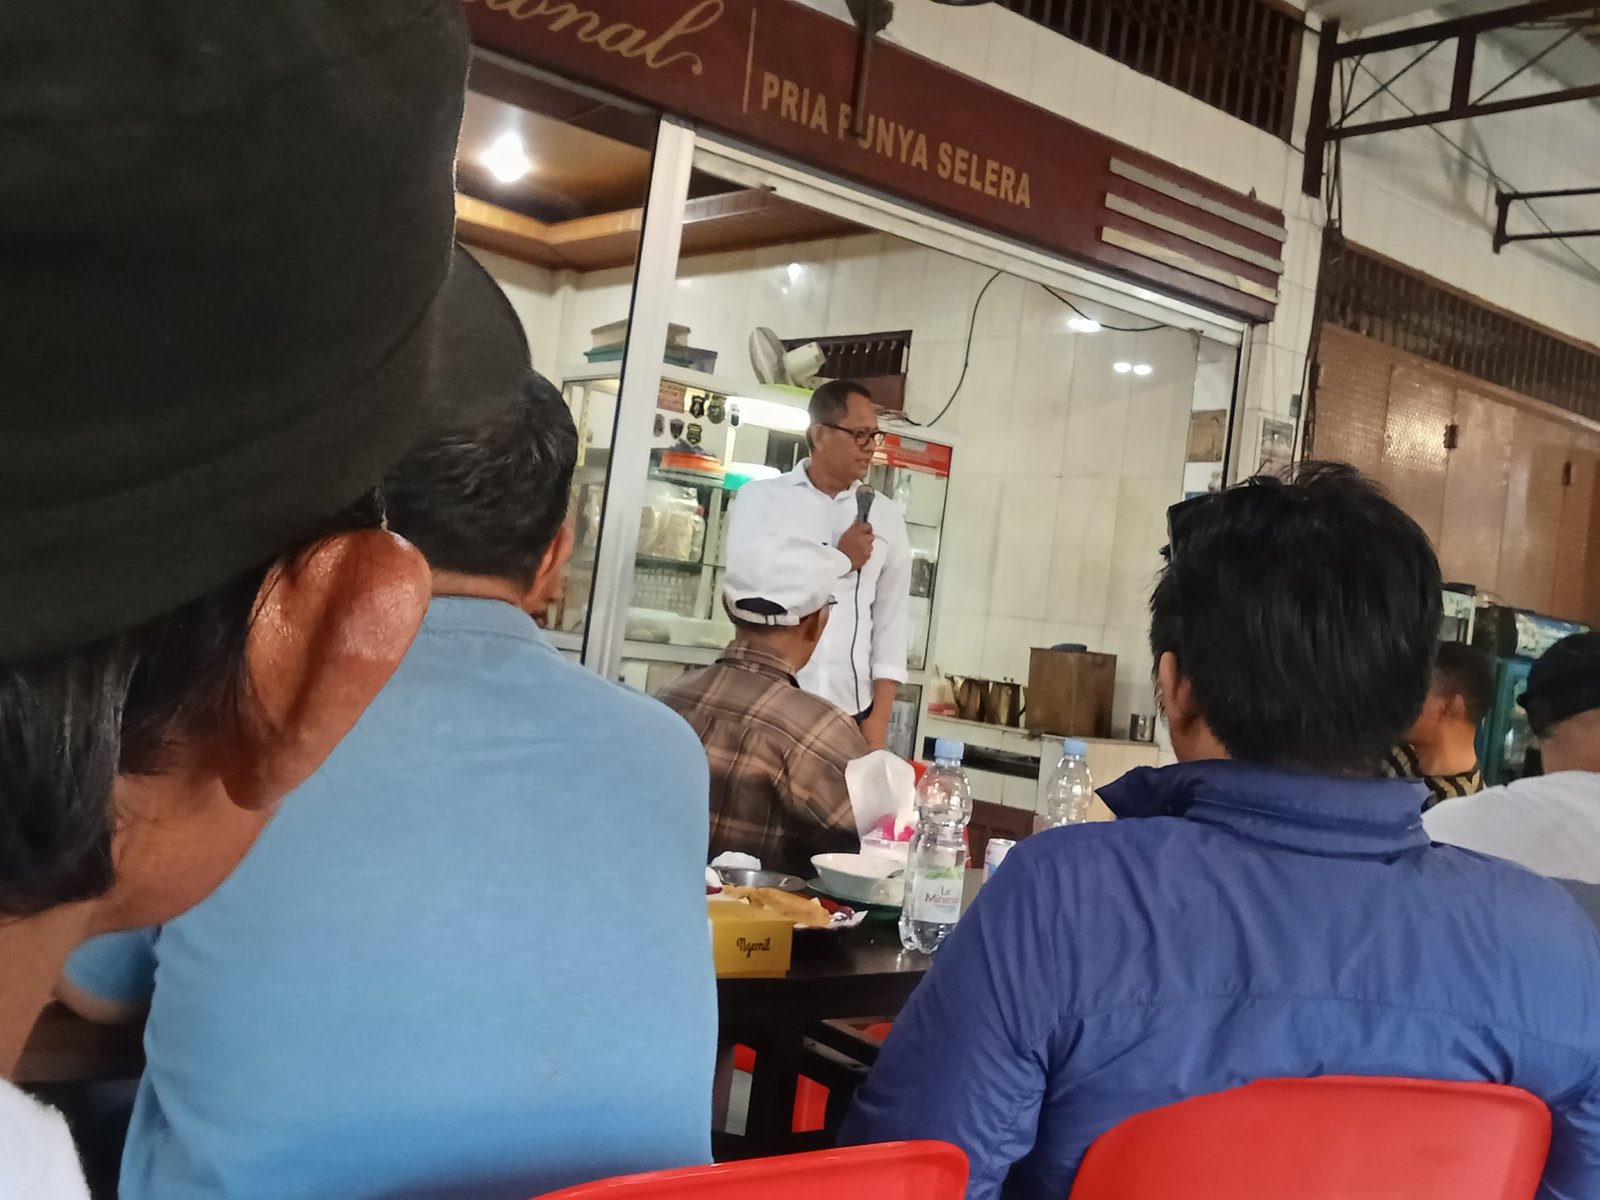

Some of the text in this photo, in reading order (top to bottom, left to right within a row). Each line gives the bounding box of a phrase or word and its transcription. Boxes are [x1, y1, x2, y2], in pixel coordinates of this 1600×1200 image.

[761, 71, 1031, 209] PRIA PUNYA SELERA
[941, 886, 952, 896] Le
